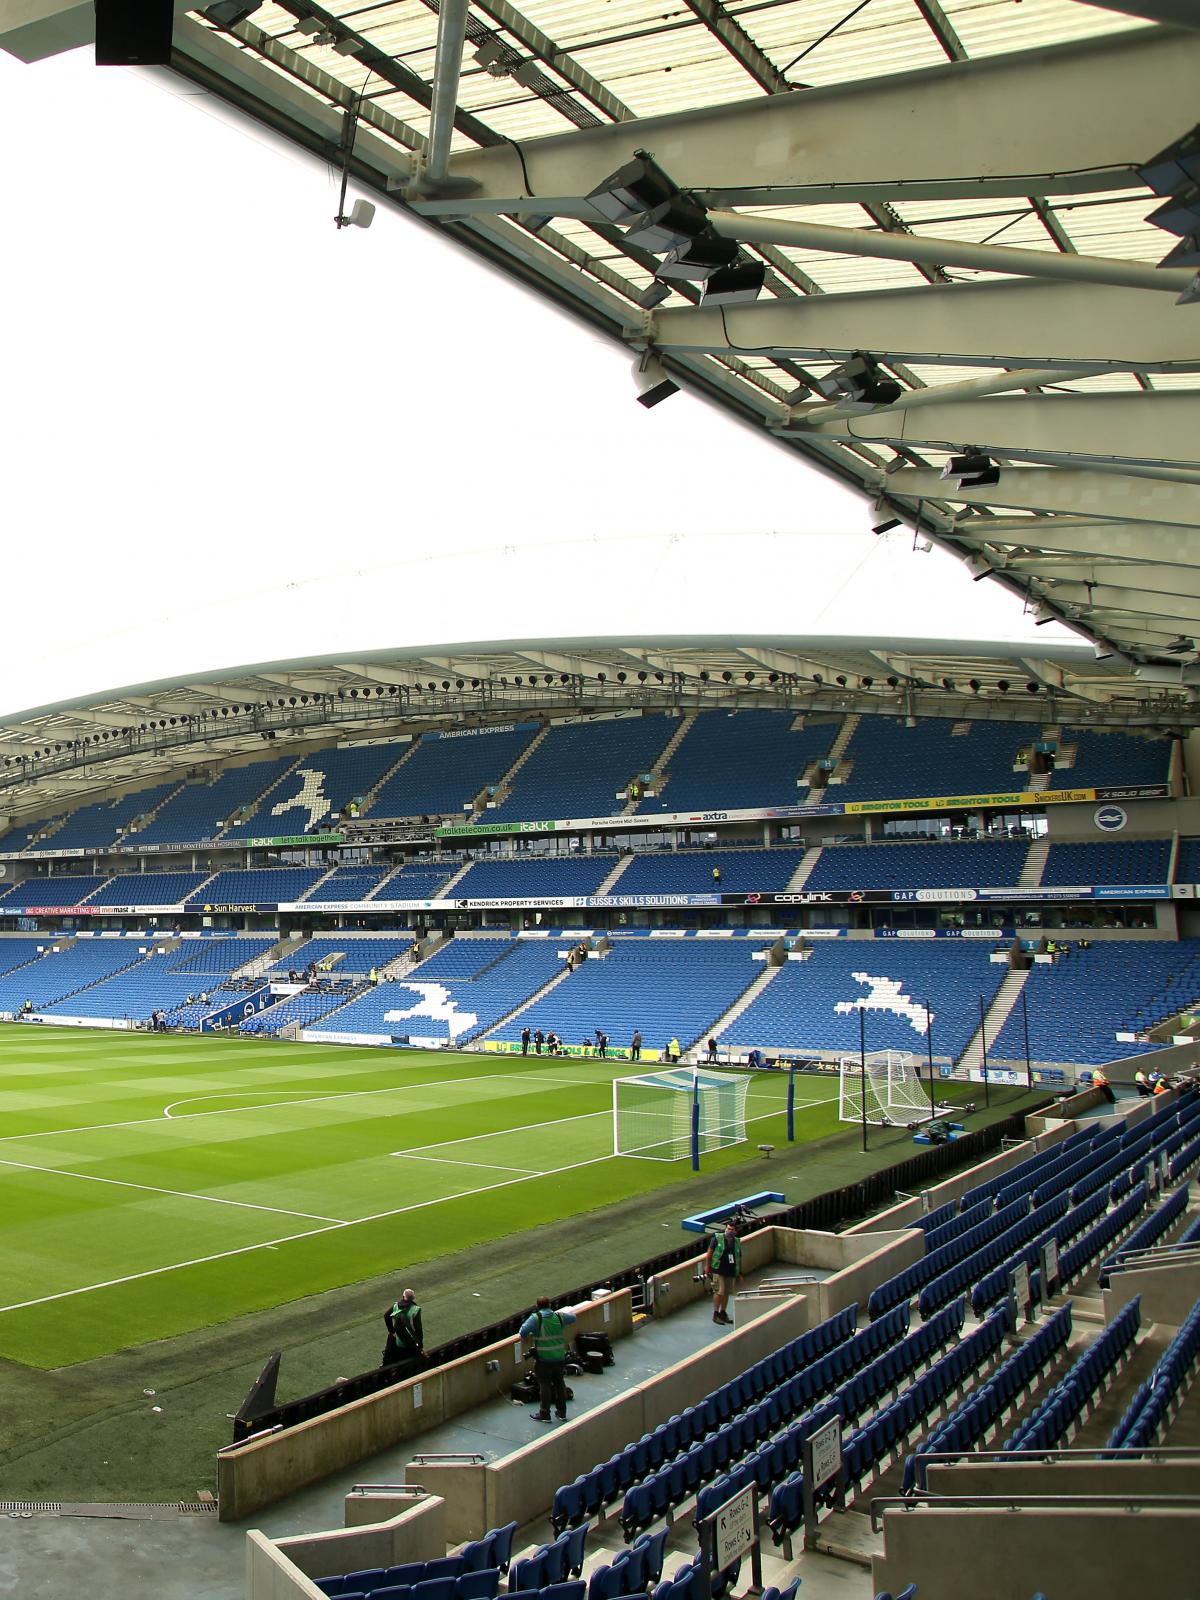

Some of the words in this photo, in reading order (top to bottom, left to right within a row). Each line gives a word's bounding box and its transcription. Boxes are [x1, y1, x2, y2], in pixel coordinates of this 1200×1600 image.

[439, 729, 478, 739] AMERICAN
[480, 725, 515, 735] EXPRESS
[947, 798, 990, 806] BRIGHTON
[702, 812, 727, 821] axtra
[442, 824, 513, 835] italktelecom.co.uk
[774, 892, 833, 903] copylink
[894, 892, 914, 900] GAP
[919, 891, 973, 900] SOLUTIONS
[589, 897, 617, 906] SUSSEX
[619, 897, 645, 905] SKILLS
[646, 896, 688, 905] SOLUTIONS
[214, 904, 227, 912] Sun
[228, 904, 257, 912] Harvest
